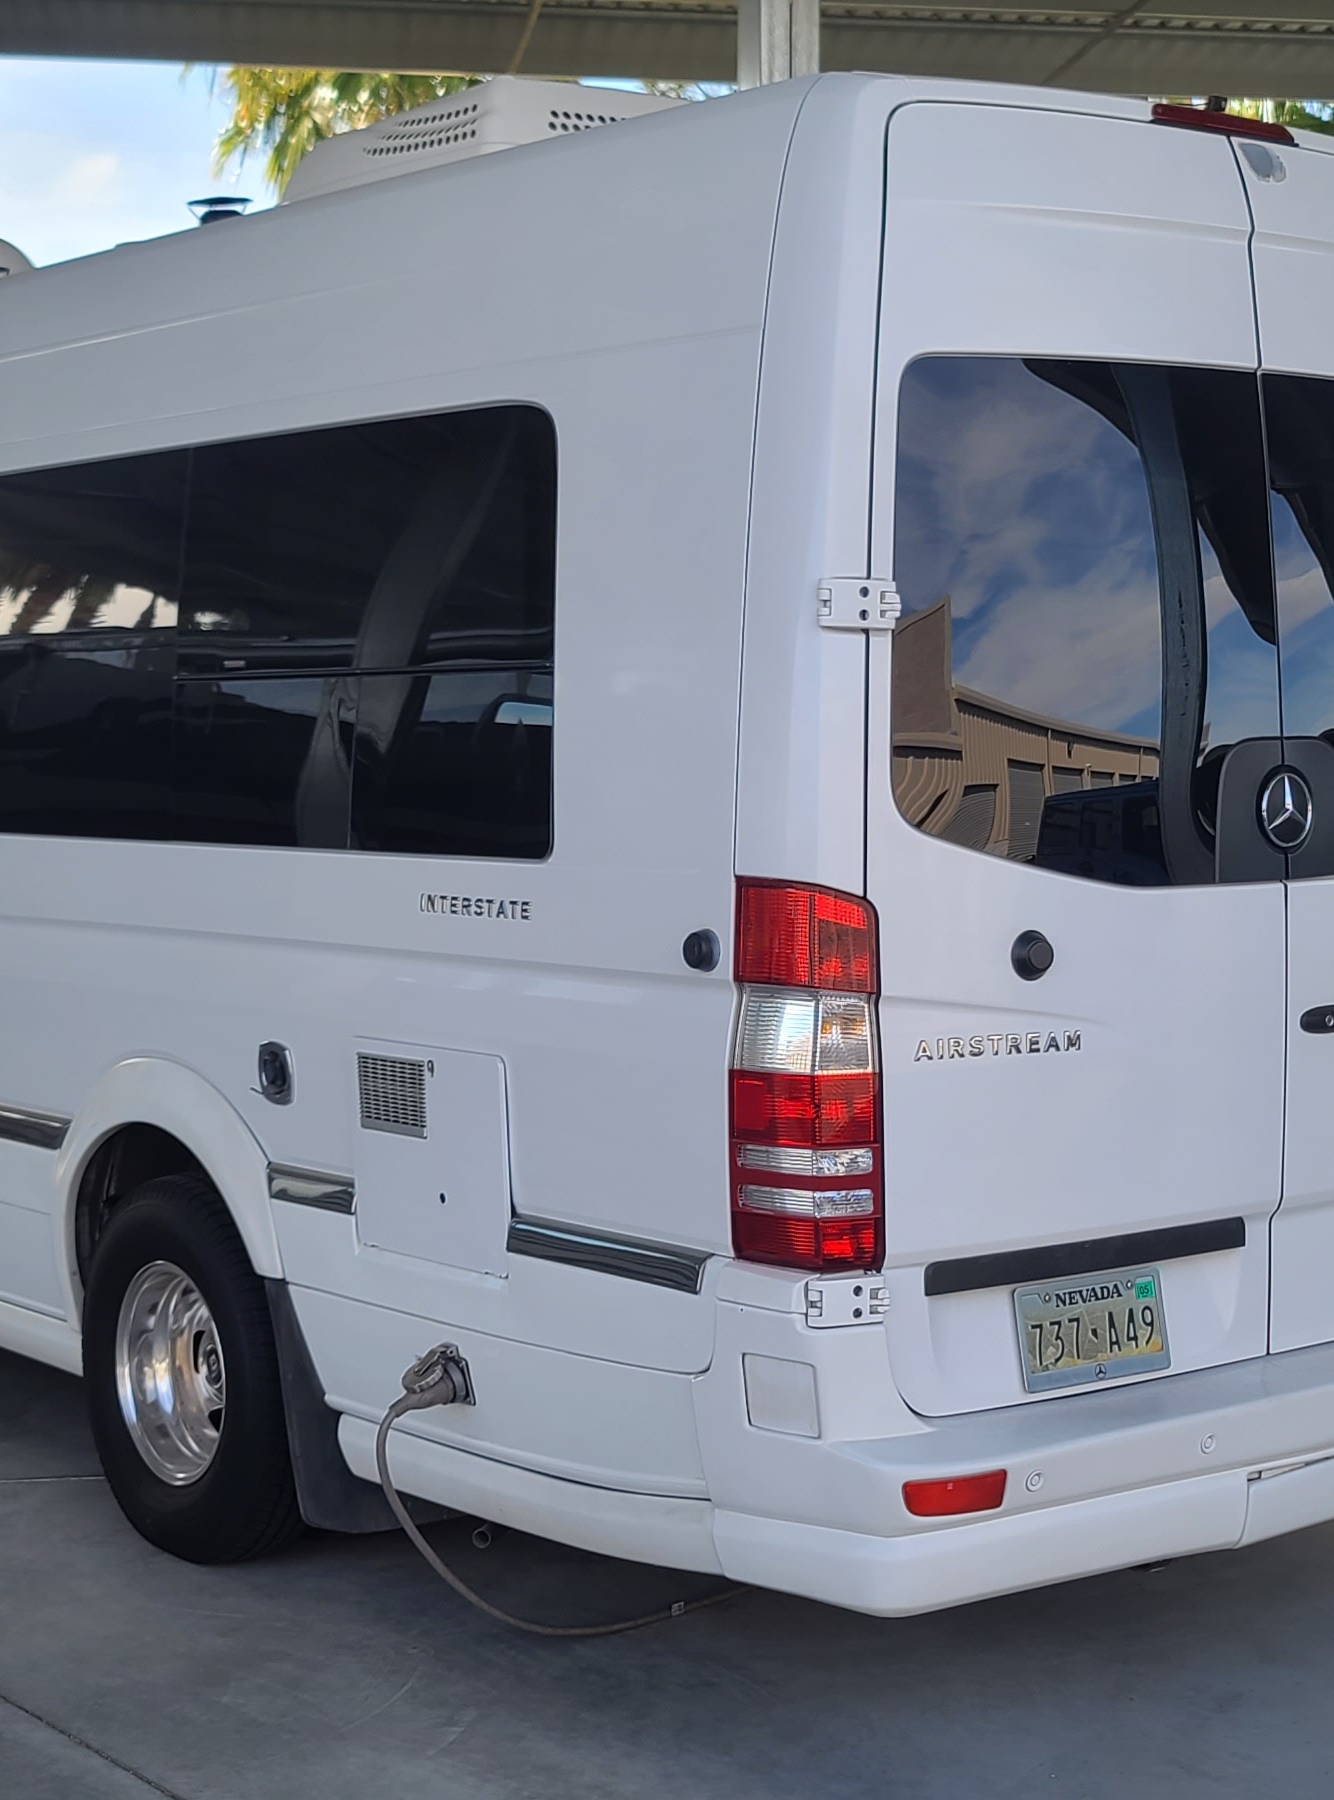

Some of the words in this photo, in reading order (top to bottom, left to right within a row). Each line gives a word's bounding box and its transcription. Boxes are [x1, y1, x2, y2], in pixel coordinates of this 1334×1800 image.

[419, 892, 532, 921] INTERSTATE
[913, 1029, 1081, 1063] AIRSTREAM
[1054, 1282, 1123, 1308] NEVADA
